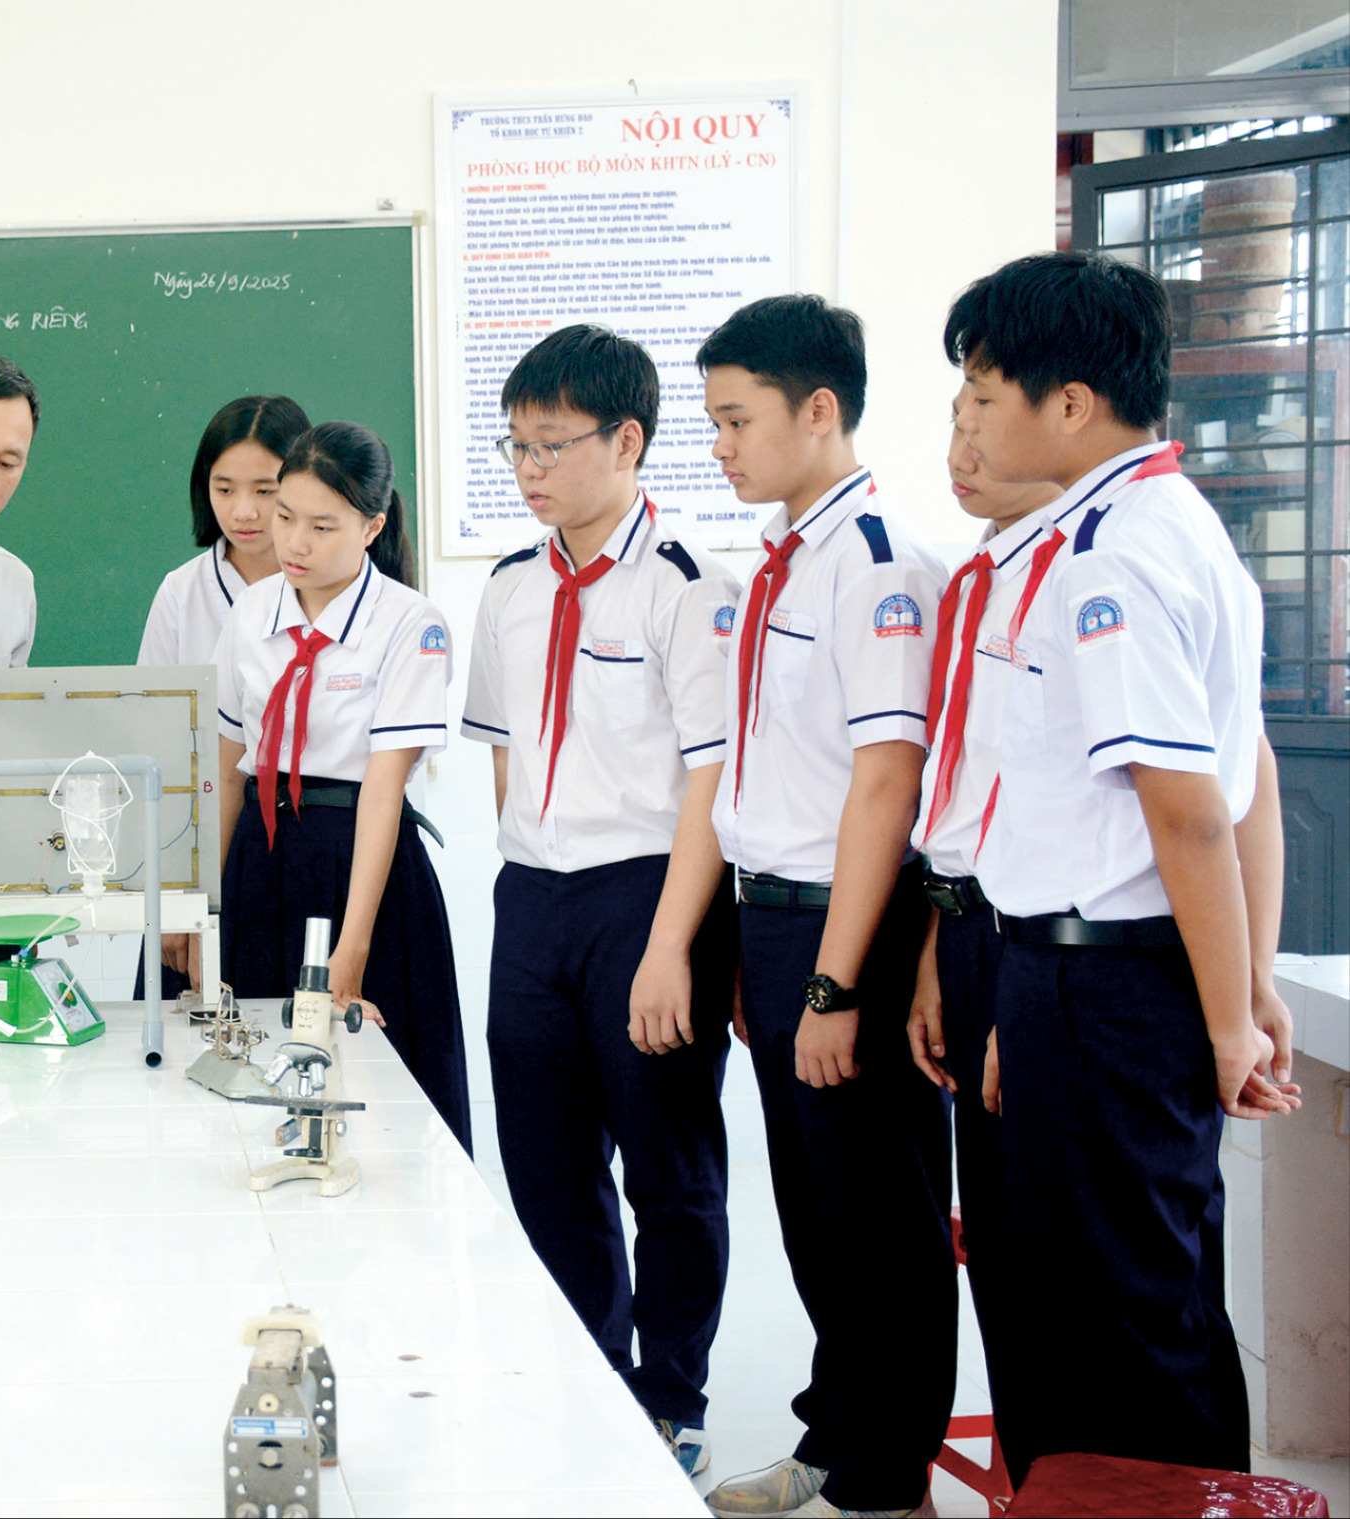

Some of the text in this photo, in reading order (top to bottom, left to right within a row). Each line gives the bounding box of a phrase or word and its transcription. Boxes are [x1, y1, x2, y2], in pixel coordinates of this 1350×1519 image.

[620, 110, 766, 148] NỘI QUY
[467, 158, 529, 178] PHÒNG
[534, 159, 572, 178] HỌC
[577, 154, 601, 178] BỘ
[605, 152, 646, 173] MÔN
[651, 154, 700, 172] KHTN
[704, 150, 732, 170] (LÝ
[746, 152, 776, 169] CN)
[31, 305, 88, 331] RIÊNG
[696, 510, 756, 521] BAN GIÁM HIỆU
